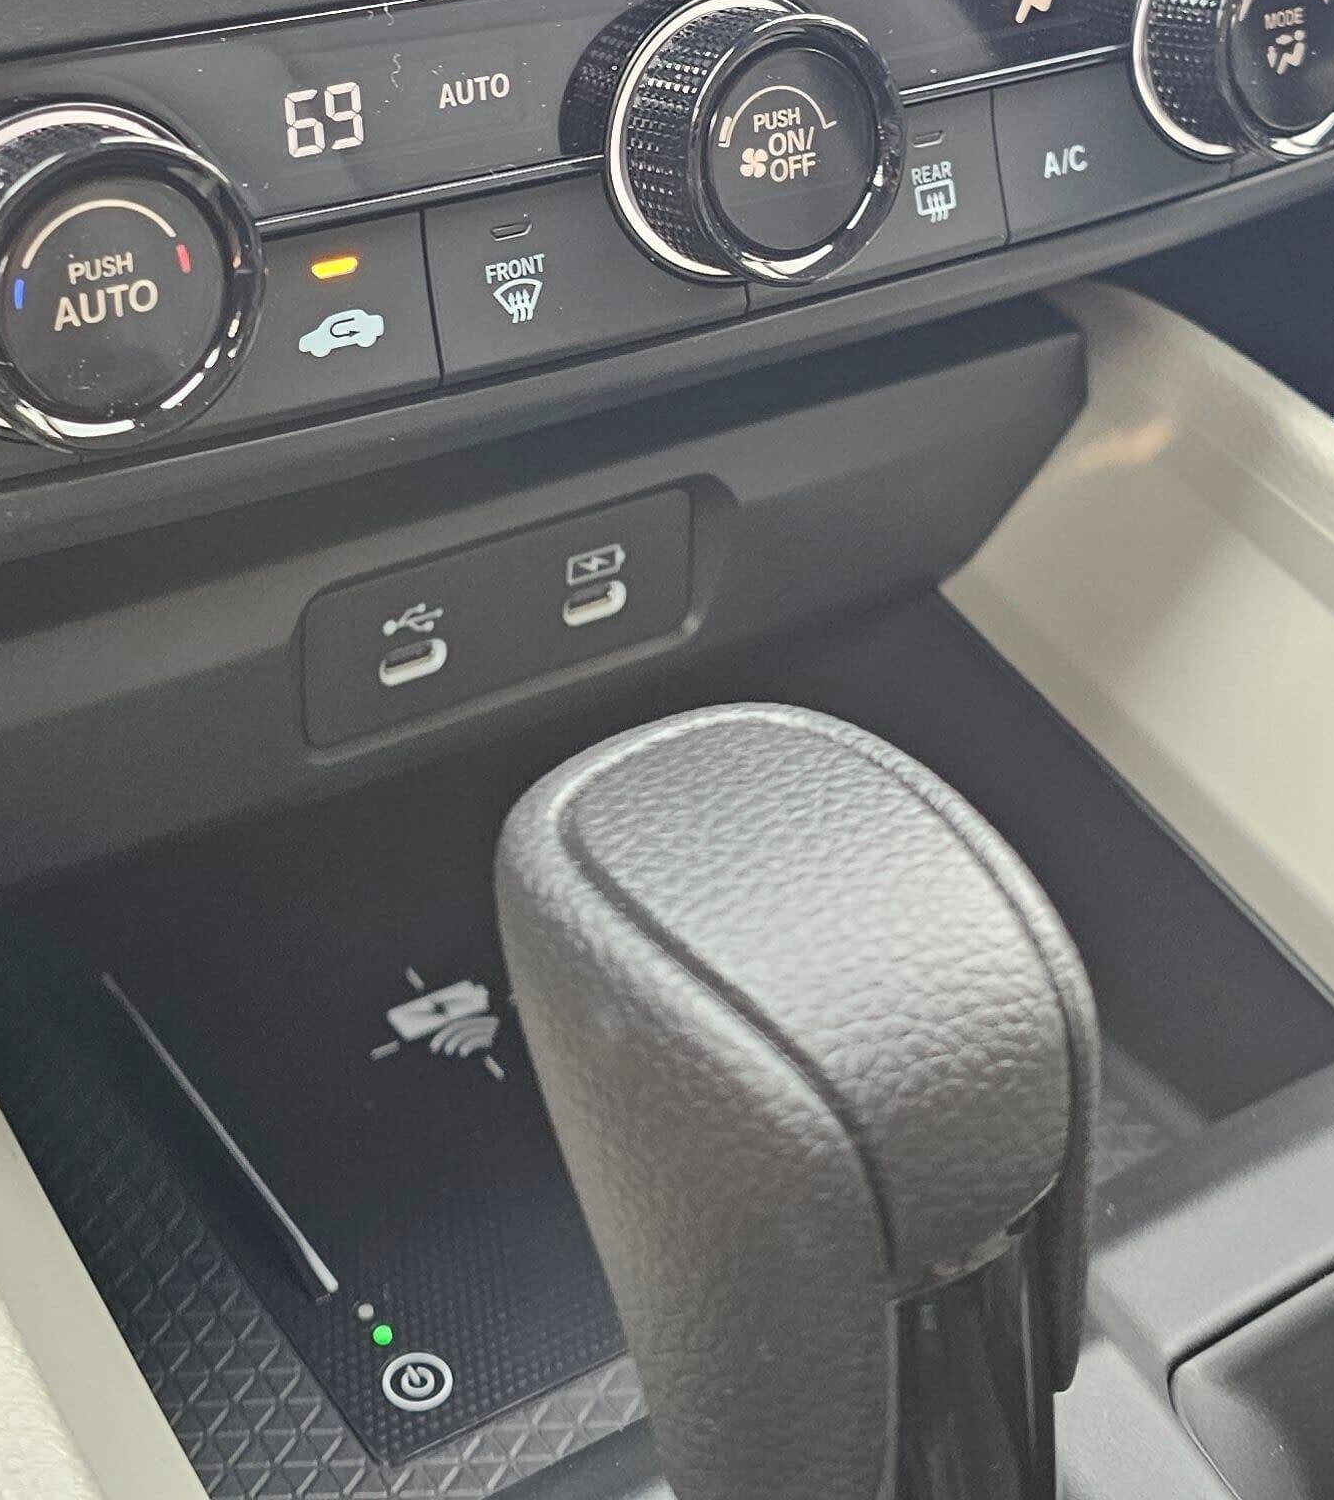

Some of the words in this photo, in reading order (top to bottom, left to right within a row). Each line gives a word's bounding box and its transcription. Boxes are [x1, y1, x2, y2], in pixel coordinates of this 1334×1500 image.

[1264, 7, 1305, 30] MODE
[439, 73, 511, 109] AUTO
[284, 81, 364, 158] 69
[753, 107, 801, 133] PUSH
[768, 126, 815, 157] ON/
[769, 152, 817, 182] OFF
[911, 161, 953, 186] REAR
[1043, 145, 1089, 179] A/C
[68, 252, 134, 285] PUSH
[485, 253, 546, 284] FRONT
[54, 279, 159, 332] AUTO
